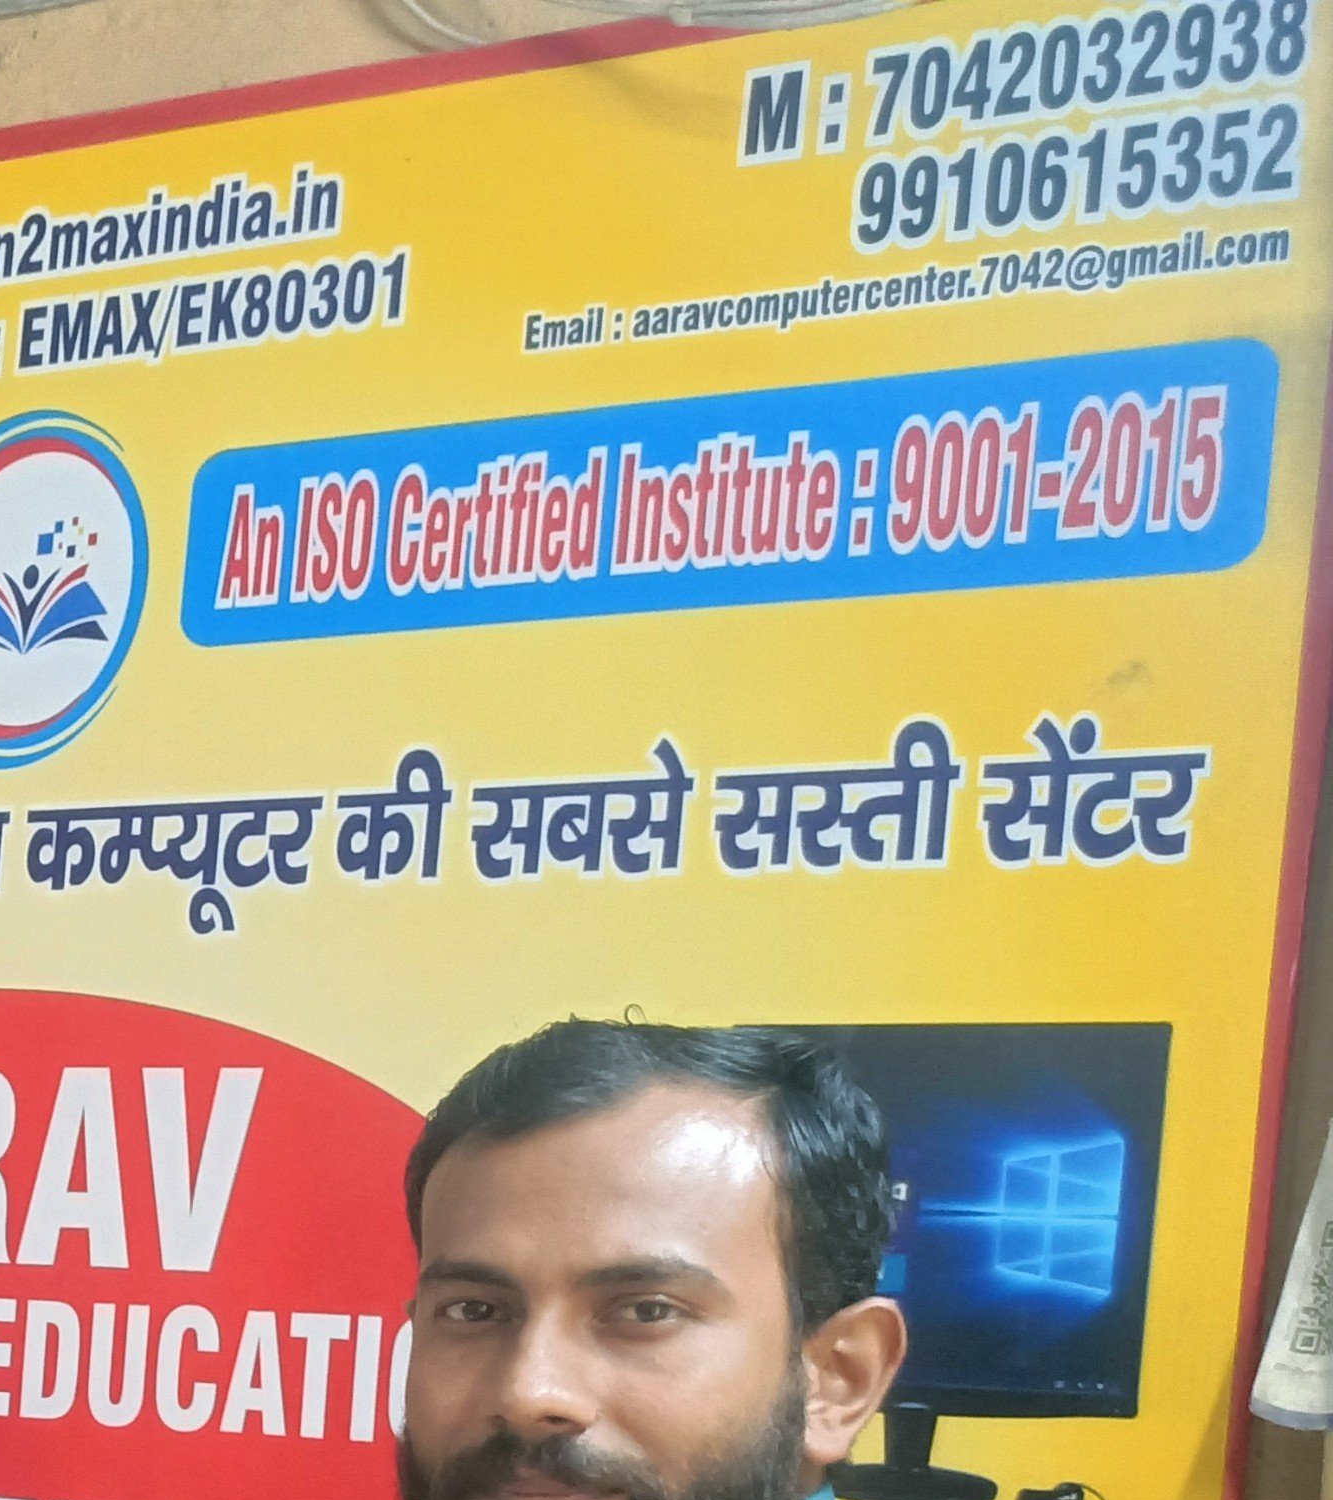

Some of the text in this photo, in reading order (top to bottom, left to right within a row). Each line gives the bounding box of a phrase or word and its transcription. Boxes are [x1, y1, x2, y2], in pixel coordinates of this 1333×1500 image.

[743, 72, 805, 158] M
[869, 0, 1309, 138] 7042032938
[854, 105, 1301, 246] 9910615352
[18, 252, 410, 371] EMAX/EK80301
[523, 305, 605, 351] Email
[631, 228, 1291, 339] aaravcomputercenter.7042@gmail.com
[219, 492, 282, 602] An
[293, 475, 377, 597] ISO
[388, 449, 603, 591] Certified
[612, 431, 836, 567] Institute
[886, 395, 1225, 550] 9001-2015
[26, 795, 326, 935] कम्प्यूटर
[336, 748, 453, 881] की
[471, 737, 695, 878] सबसे
[714, 719, 963, 870] सस्ती
[979, 715, 1209, 860] सेंटर
